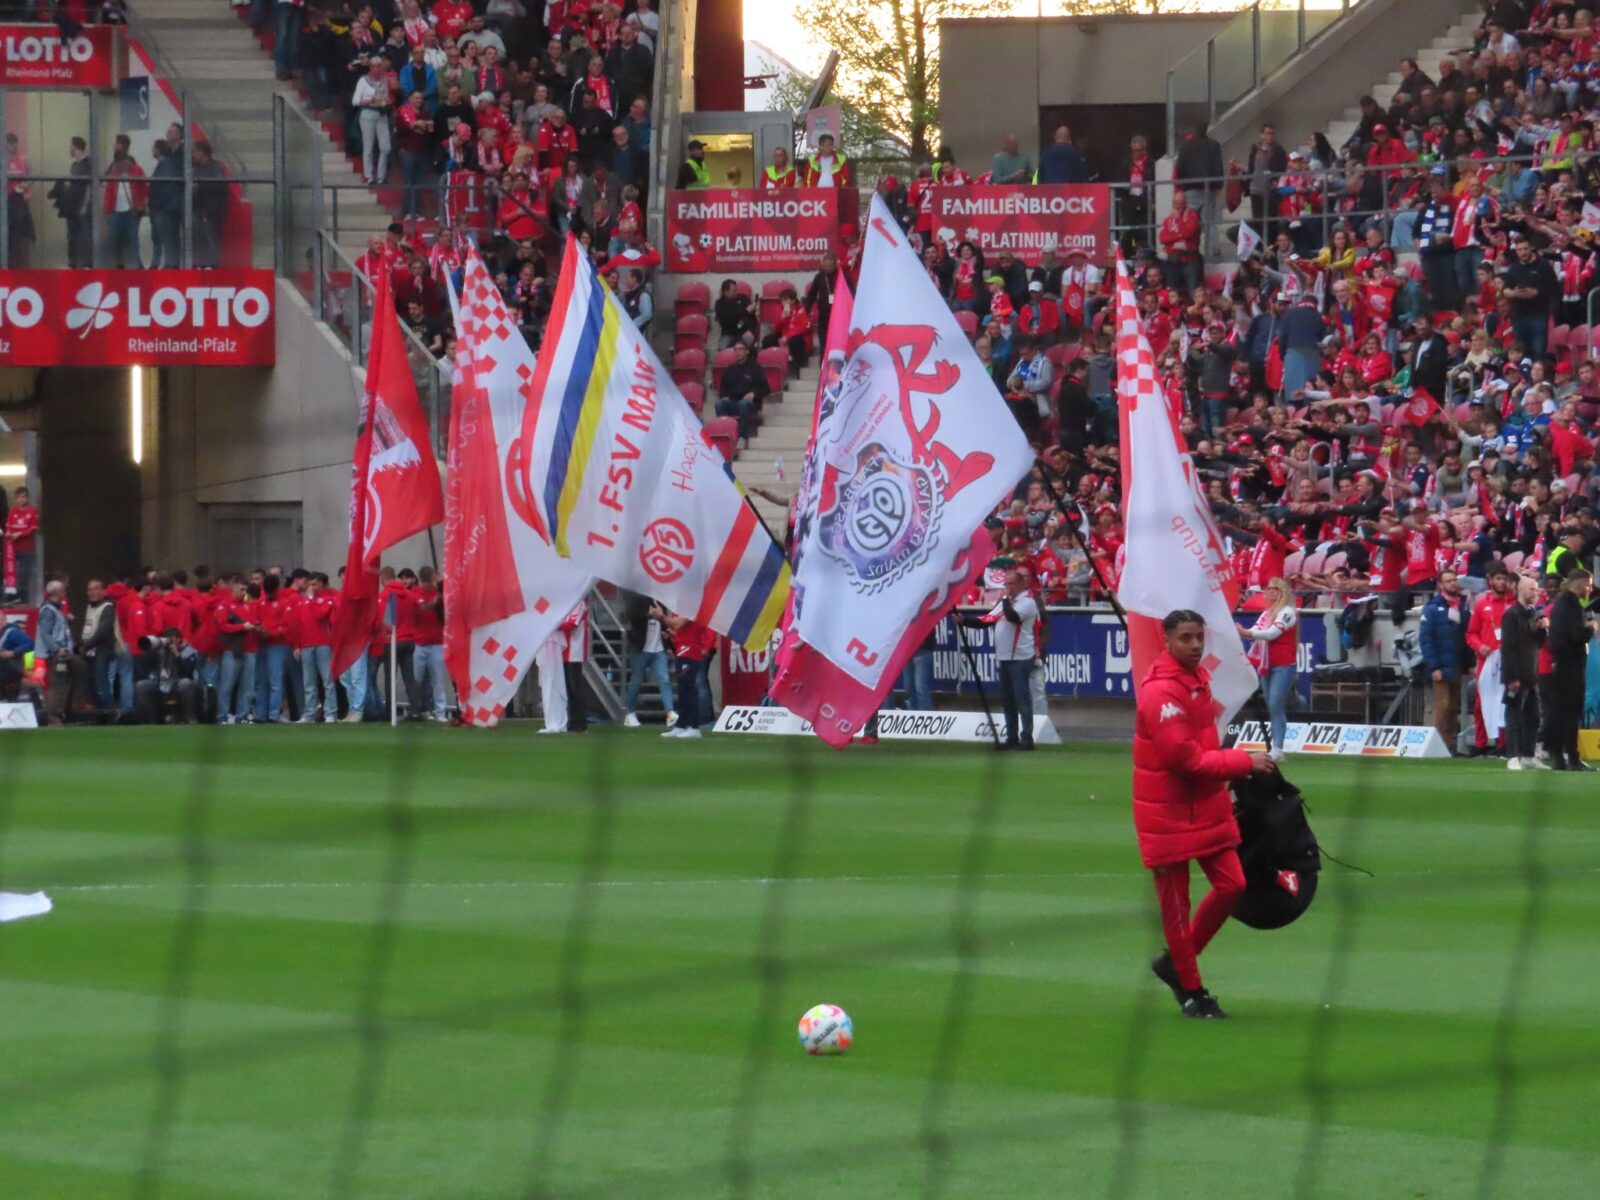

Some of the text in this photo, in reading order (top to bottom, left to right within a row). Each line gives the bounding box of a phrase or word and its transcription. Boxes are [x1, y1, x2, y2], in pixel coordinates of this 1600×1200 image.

[6, 36, 93, 62] LOTTO
[6, 67, 73, 78] Rheinland-Pfalz
[678, 200, 827, 219] FAMILIENBLOCK
[942, 197, 1095, 215] FAMILIENBLOCK
[716, 235, 828, 252] PLATINUM.com
[981, 231, 1096, 249] PLATINUM.com
[128, 287, 270, 327] LOTTO
[128, 338, 236, 353] Rheinland-Pfalz
[599, 433, 641, 513] FSV
[877, 714, 956, 736] TOMORROW
[1305, 725, 1342, 743] NTA
[1364, 728, 1402, 747] NTA
